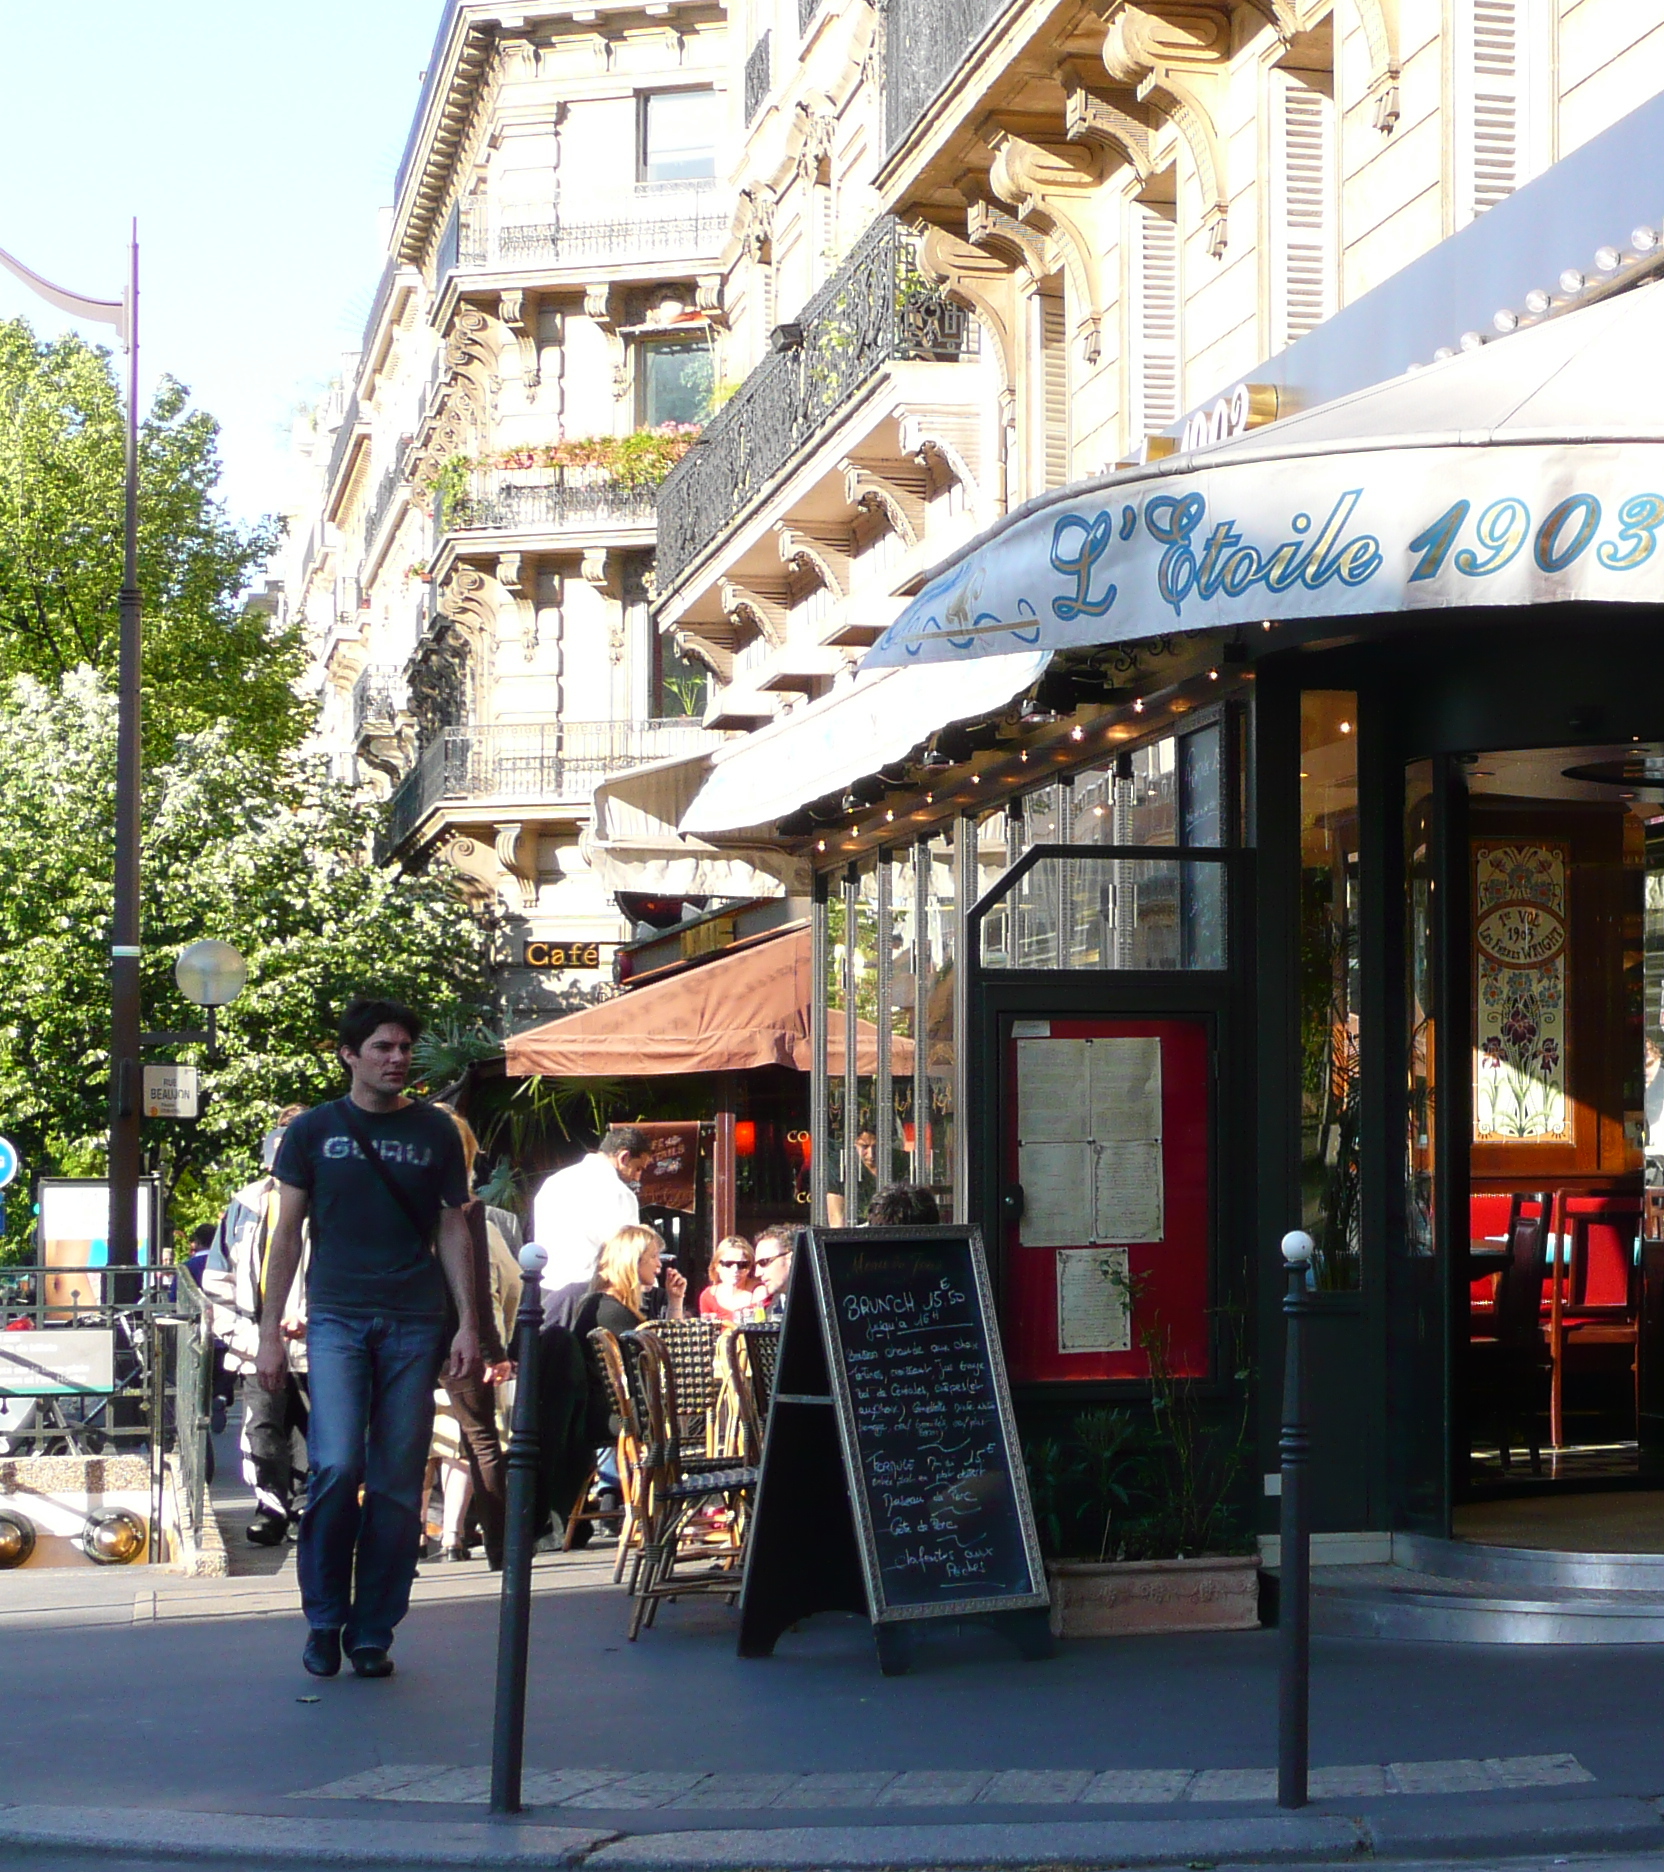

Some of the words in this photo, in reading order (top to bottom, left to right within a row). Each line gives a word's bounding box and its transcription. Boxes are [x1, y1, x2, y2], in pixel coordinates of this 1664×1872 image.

[1050, 487, 1384, 622] L'Etoile
[1517, 910, 1541, 927] VOL
[1508, 926, 1534, 944] 1903
[1521, 926, 1563, 960] WRIGHT
[527, 942, 599, 966] Café
[843, 1291, 914, 1320] BRUNCH
